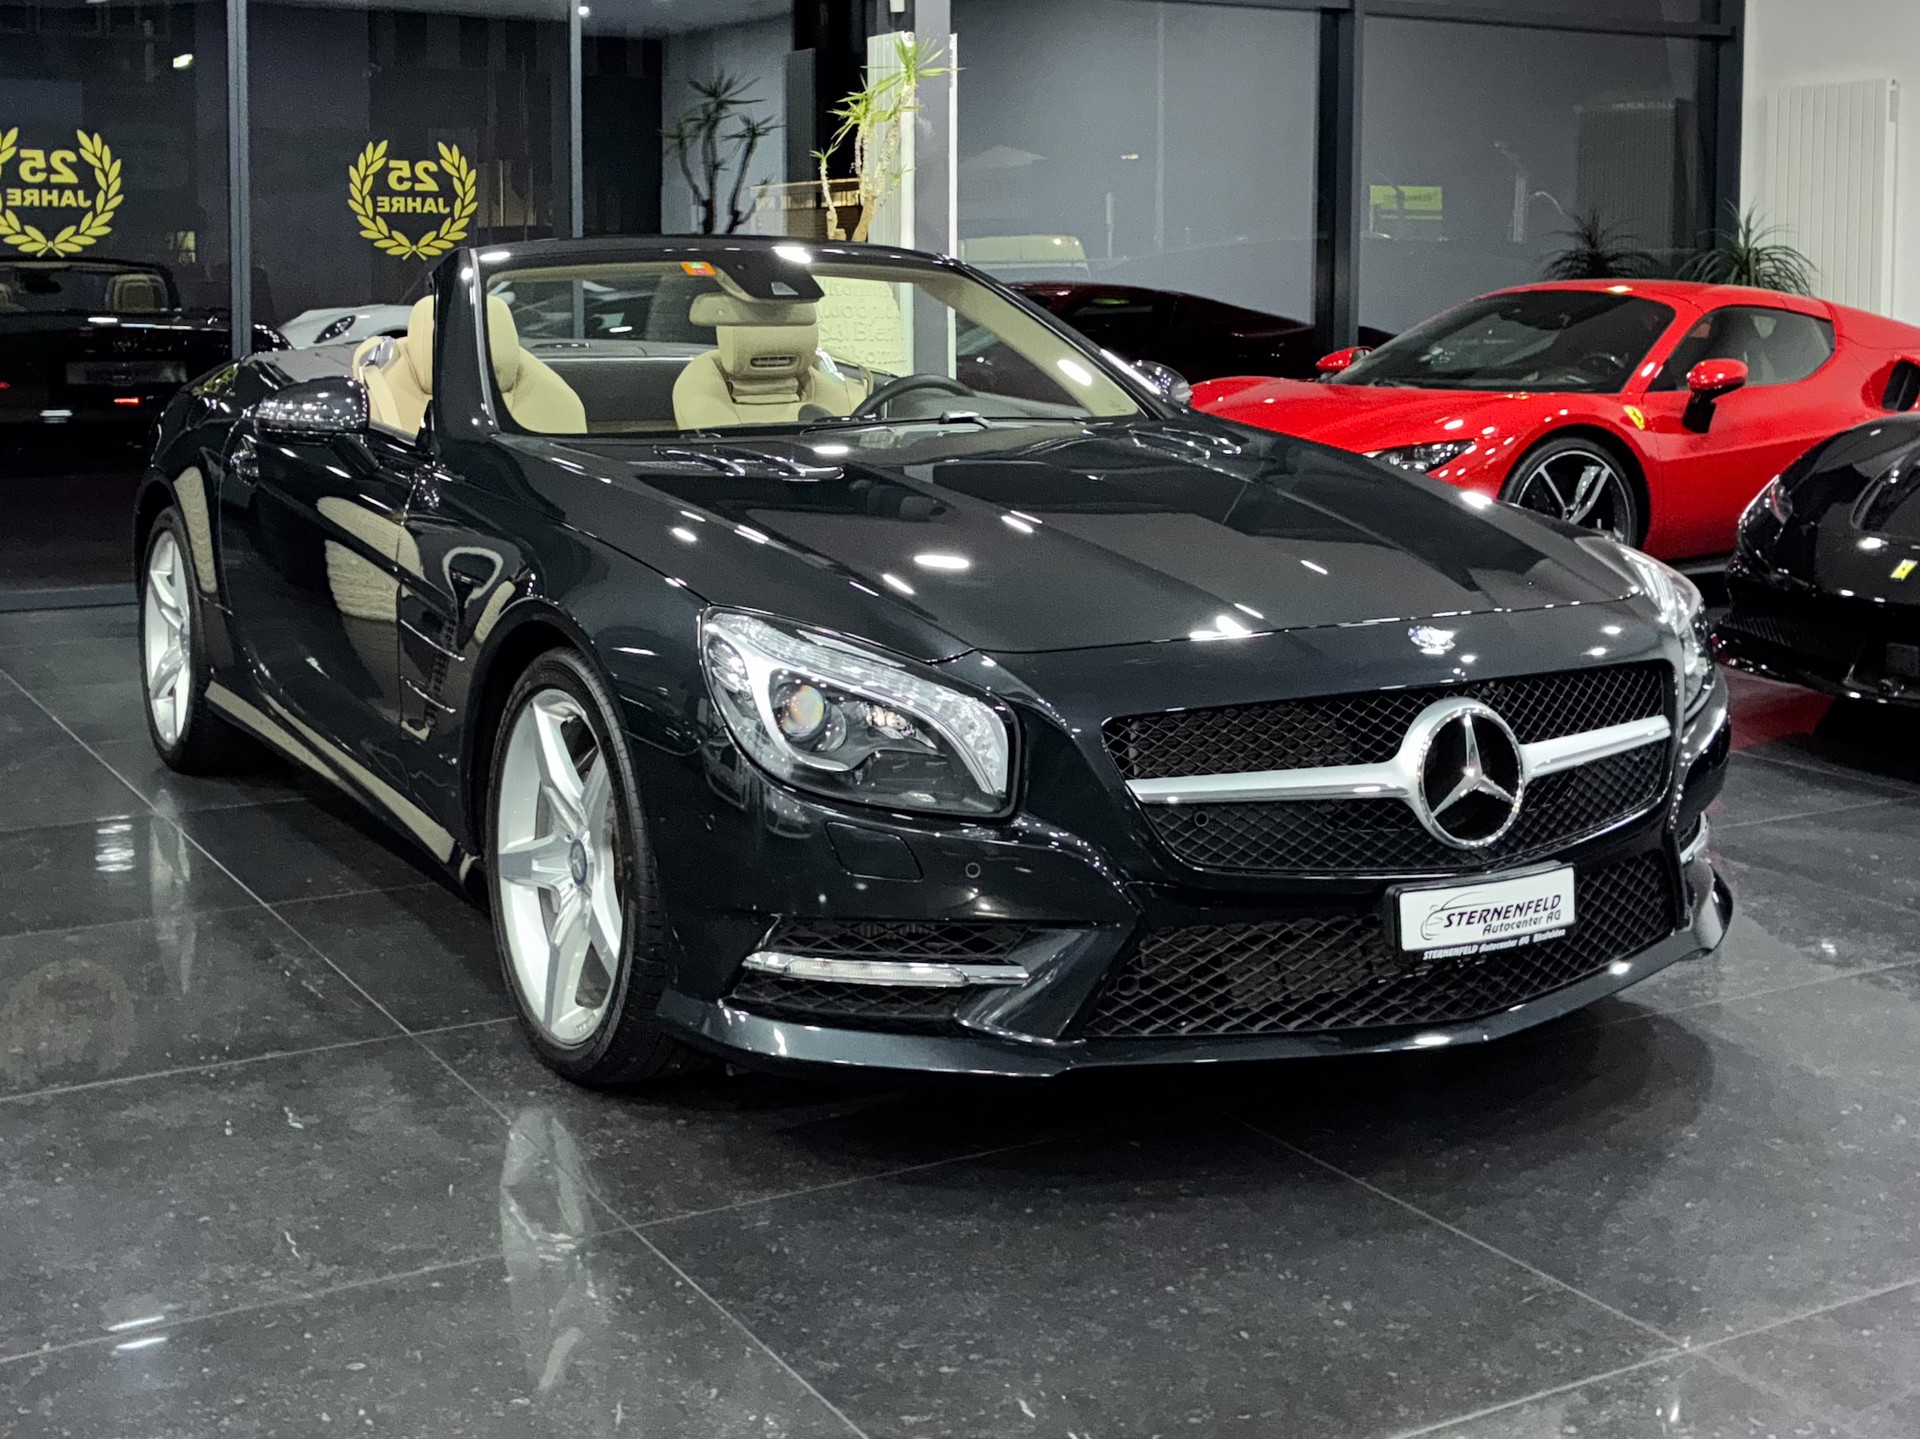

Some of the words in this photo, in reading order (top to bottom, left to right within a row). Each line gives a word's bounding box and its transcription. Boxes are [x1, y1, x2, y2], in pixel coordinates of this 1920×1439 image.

[1443, 894, 1561, 928] STERNENFELD
[1483, 916, 1543, 936] Autocenter
[1546, 909, 1561, 923] AG
[1423, 944, 1479, 960] STERNENFELD
